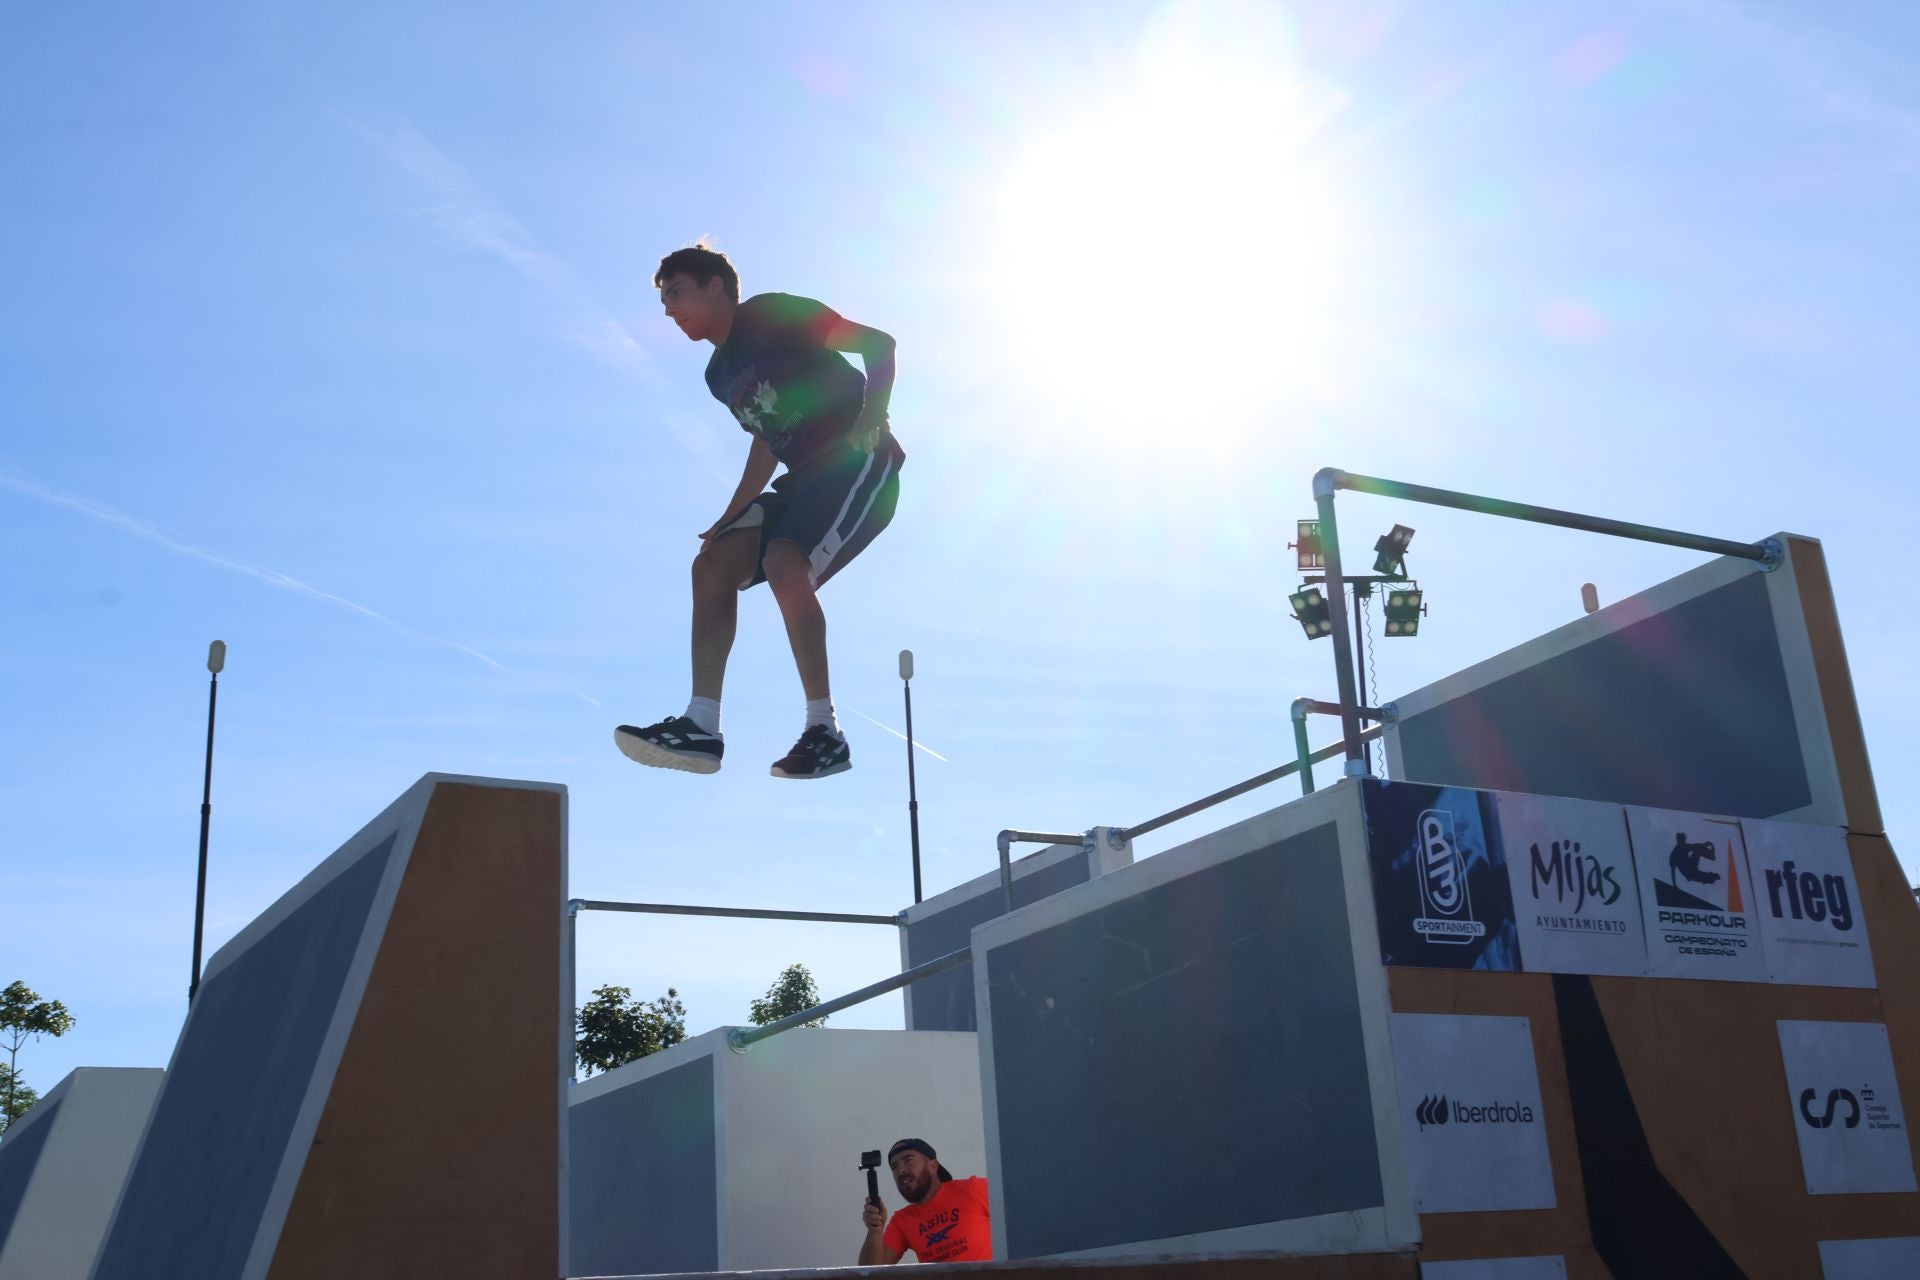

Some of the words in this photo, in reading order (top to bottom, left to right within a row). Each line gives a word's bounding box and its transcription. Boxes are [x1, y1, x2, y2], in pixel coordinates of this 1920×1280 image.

[1530, 839, 1621, 914] Mijas
[1765, 860, 1853, 931] rfeg
[1416, 920, 1482, 934] SPORTAINMENT
[1536, 916, 1627, 932] AYUNTAMIENTO
[1658, 910, 1746, 929] PARKOUR
[1664, 934, 1747, 948] CAMPEONATO
[1678, 946, 1693, 955] DE
[1694, 947, 1737, 957] ESPAÑA
[1452, 1100, 1534, 1124] Iberdrola
[919, 1208, 960, 1237] ASICS
